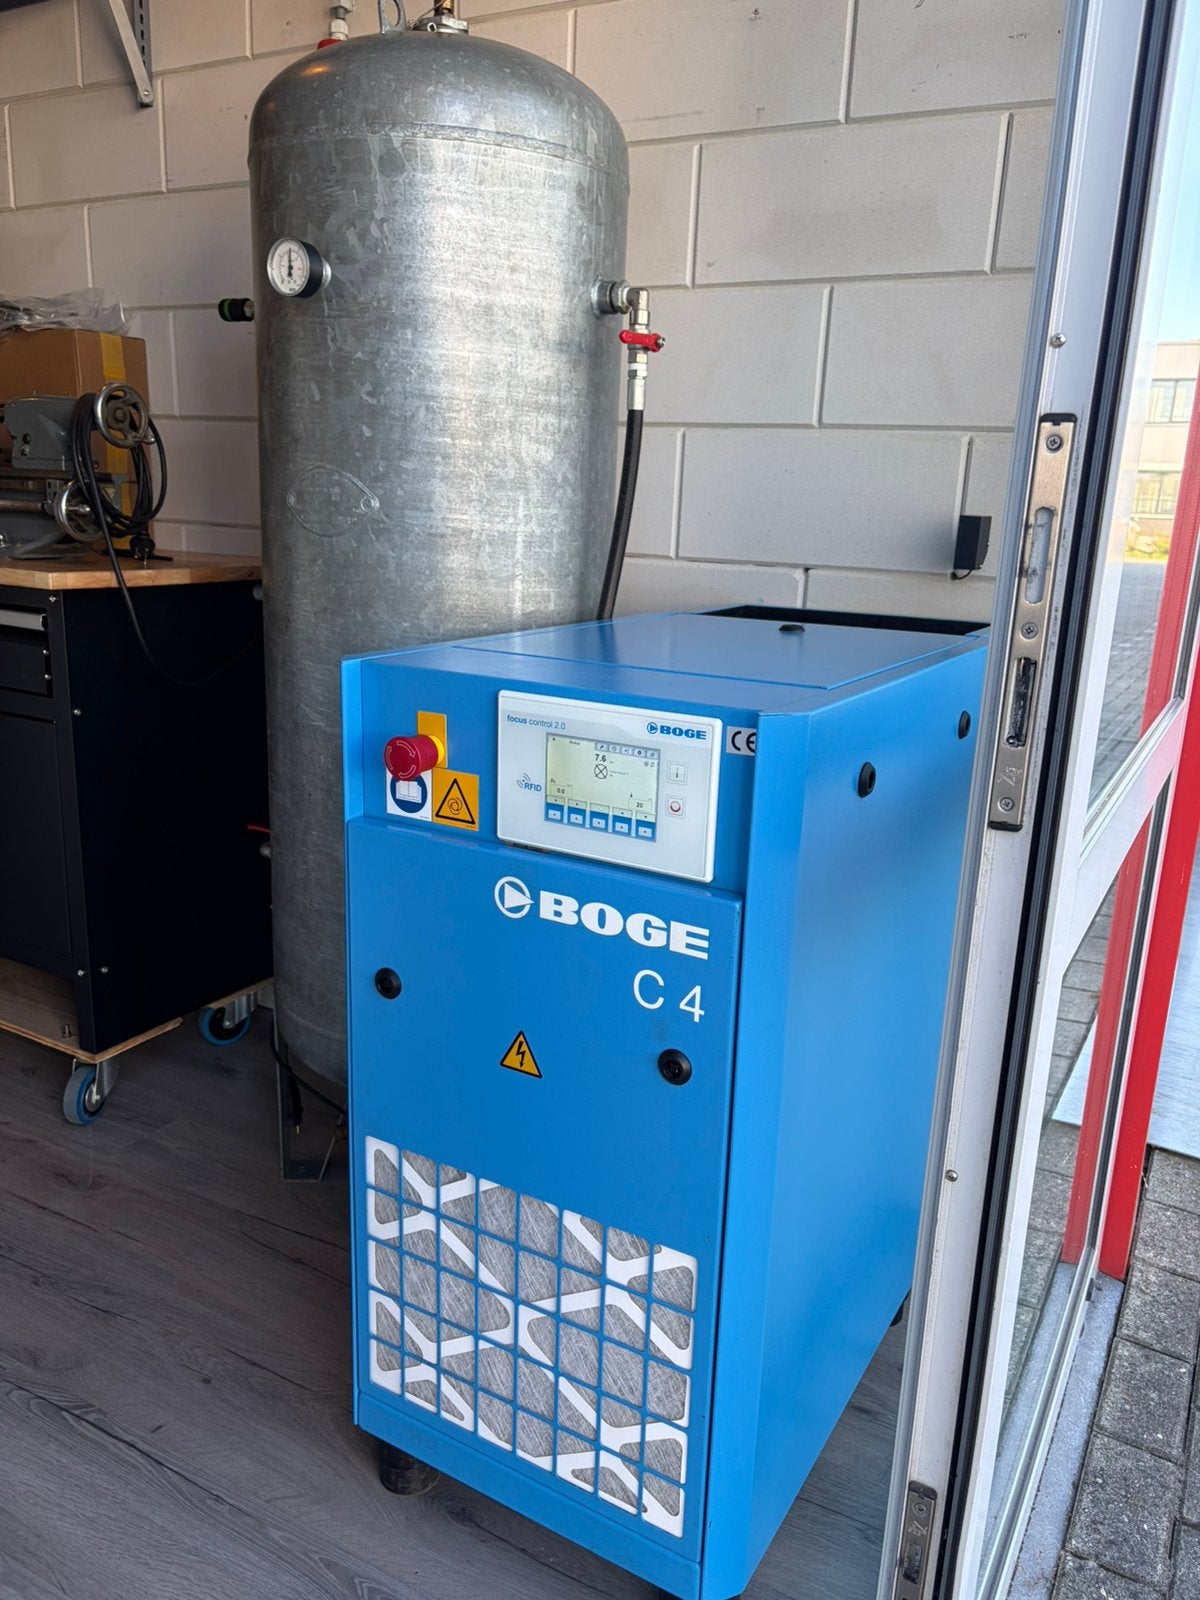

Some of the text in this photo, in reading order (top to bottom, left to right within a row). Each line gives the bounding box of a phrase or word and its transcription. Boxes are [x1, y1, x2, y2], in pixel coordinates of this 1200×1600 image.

[507, 714, 566, 730] focus control 2.0
[660, 725, 707, 740] BOGE
[595, 753, 607, 763] 7.6
[524, 782, 542, 792] RFID
[539, 889, 710, 960] BOGE
[633, 969, 705, 1023] C 4
